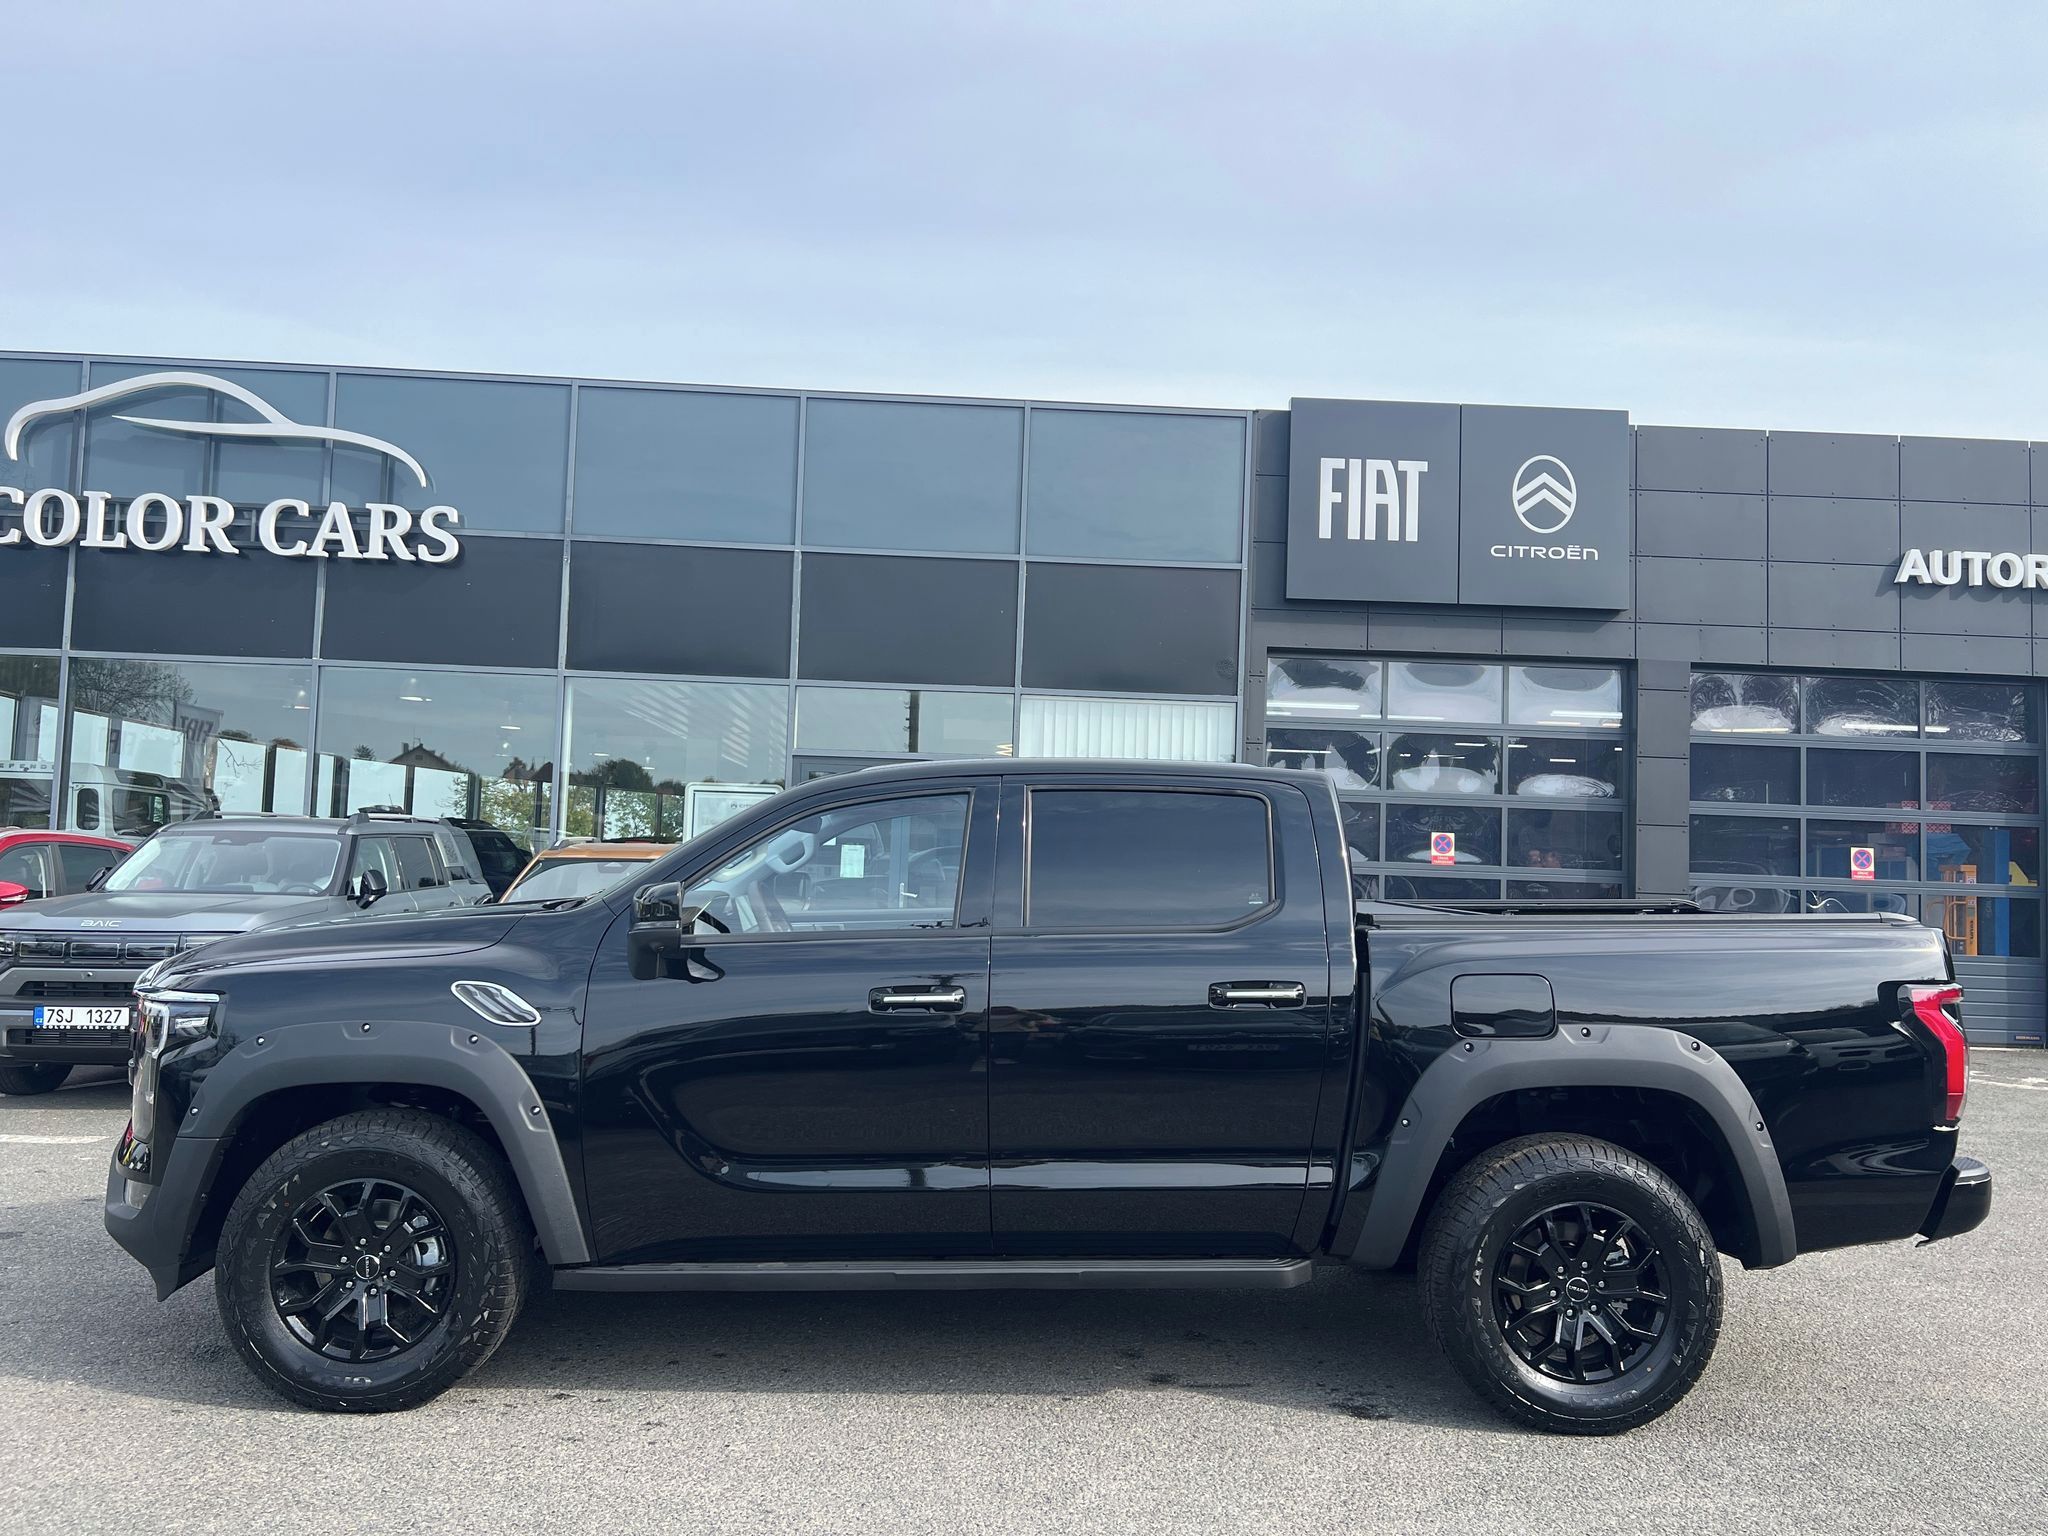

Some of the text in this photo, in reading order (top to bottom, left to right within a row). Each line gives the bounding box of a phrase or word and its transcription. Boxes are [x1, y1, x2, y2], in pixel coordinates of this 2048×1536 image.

[1318, 457, 1429, 542] FIAT
[258, 498, 460, 563] CARS
[1893, 549, 2048, 590] AUTOR
[80, 919, 122, 927] BAIC
[47, 1008, 122, 1024] 7SJ 1327
